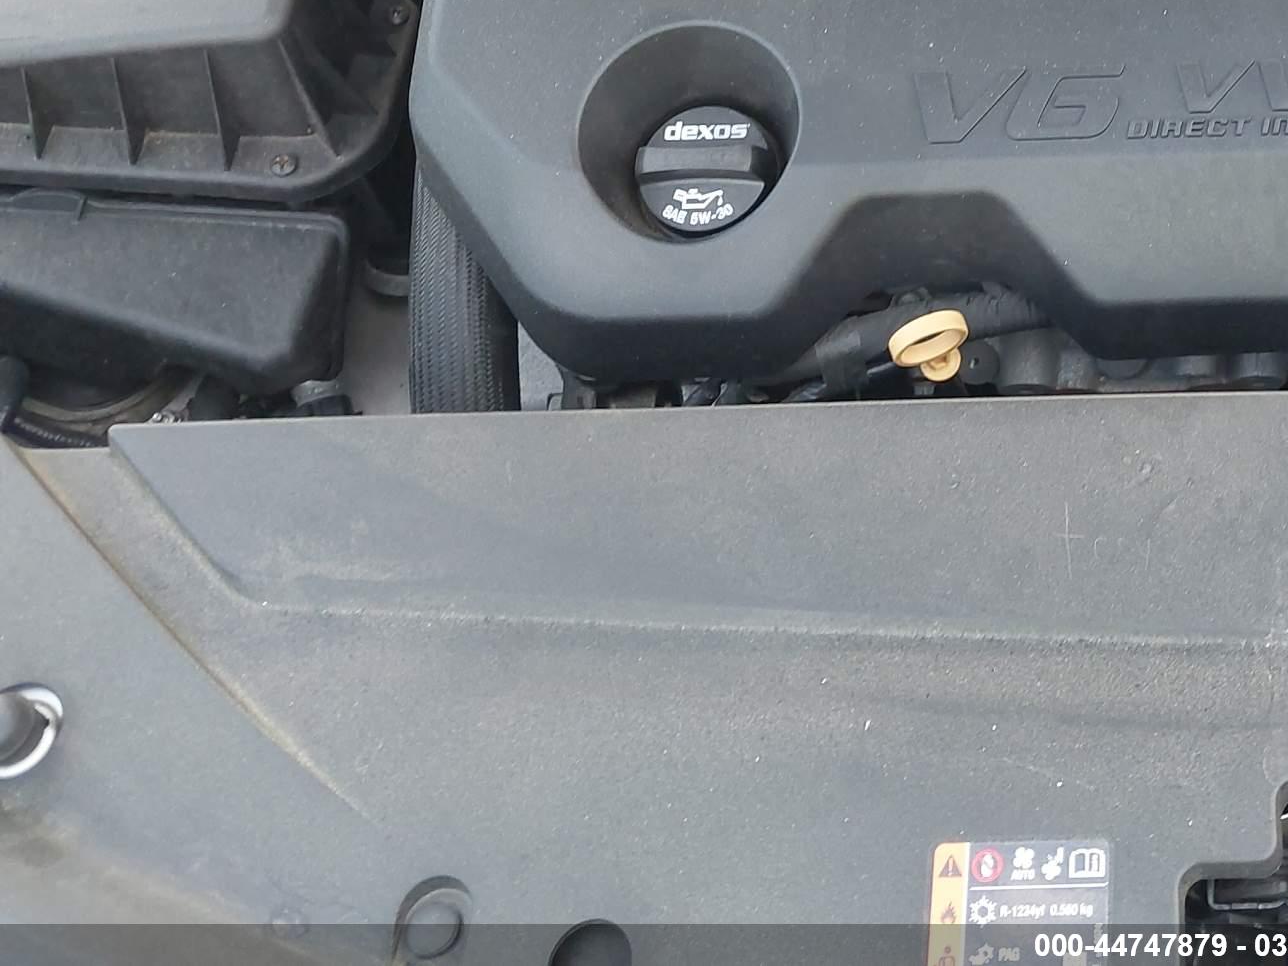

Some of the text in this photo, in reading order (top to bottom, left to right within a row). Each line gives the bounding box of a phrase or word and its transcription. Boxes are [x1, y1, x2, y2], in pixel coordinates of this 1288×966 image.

[913, 64, 1127, 145] V6
[664, 121, 750, 141] dexos
[1127, 117, 1251, 139] DIRECT
[662, 204, 688, 224] SAE
